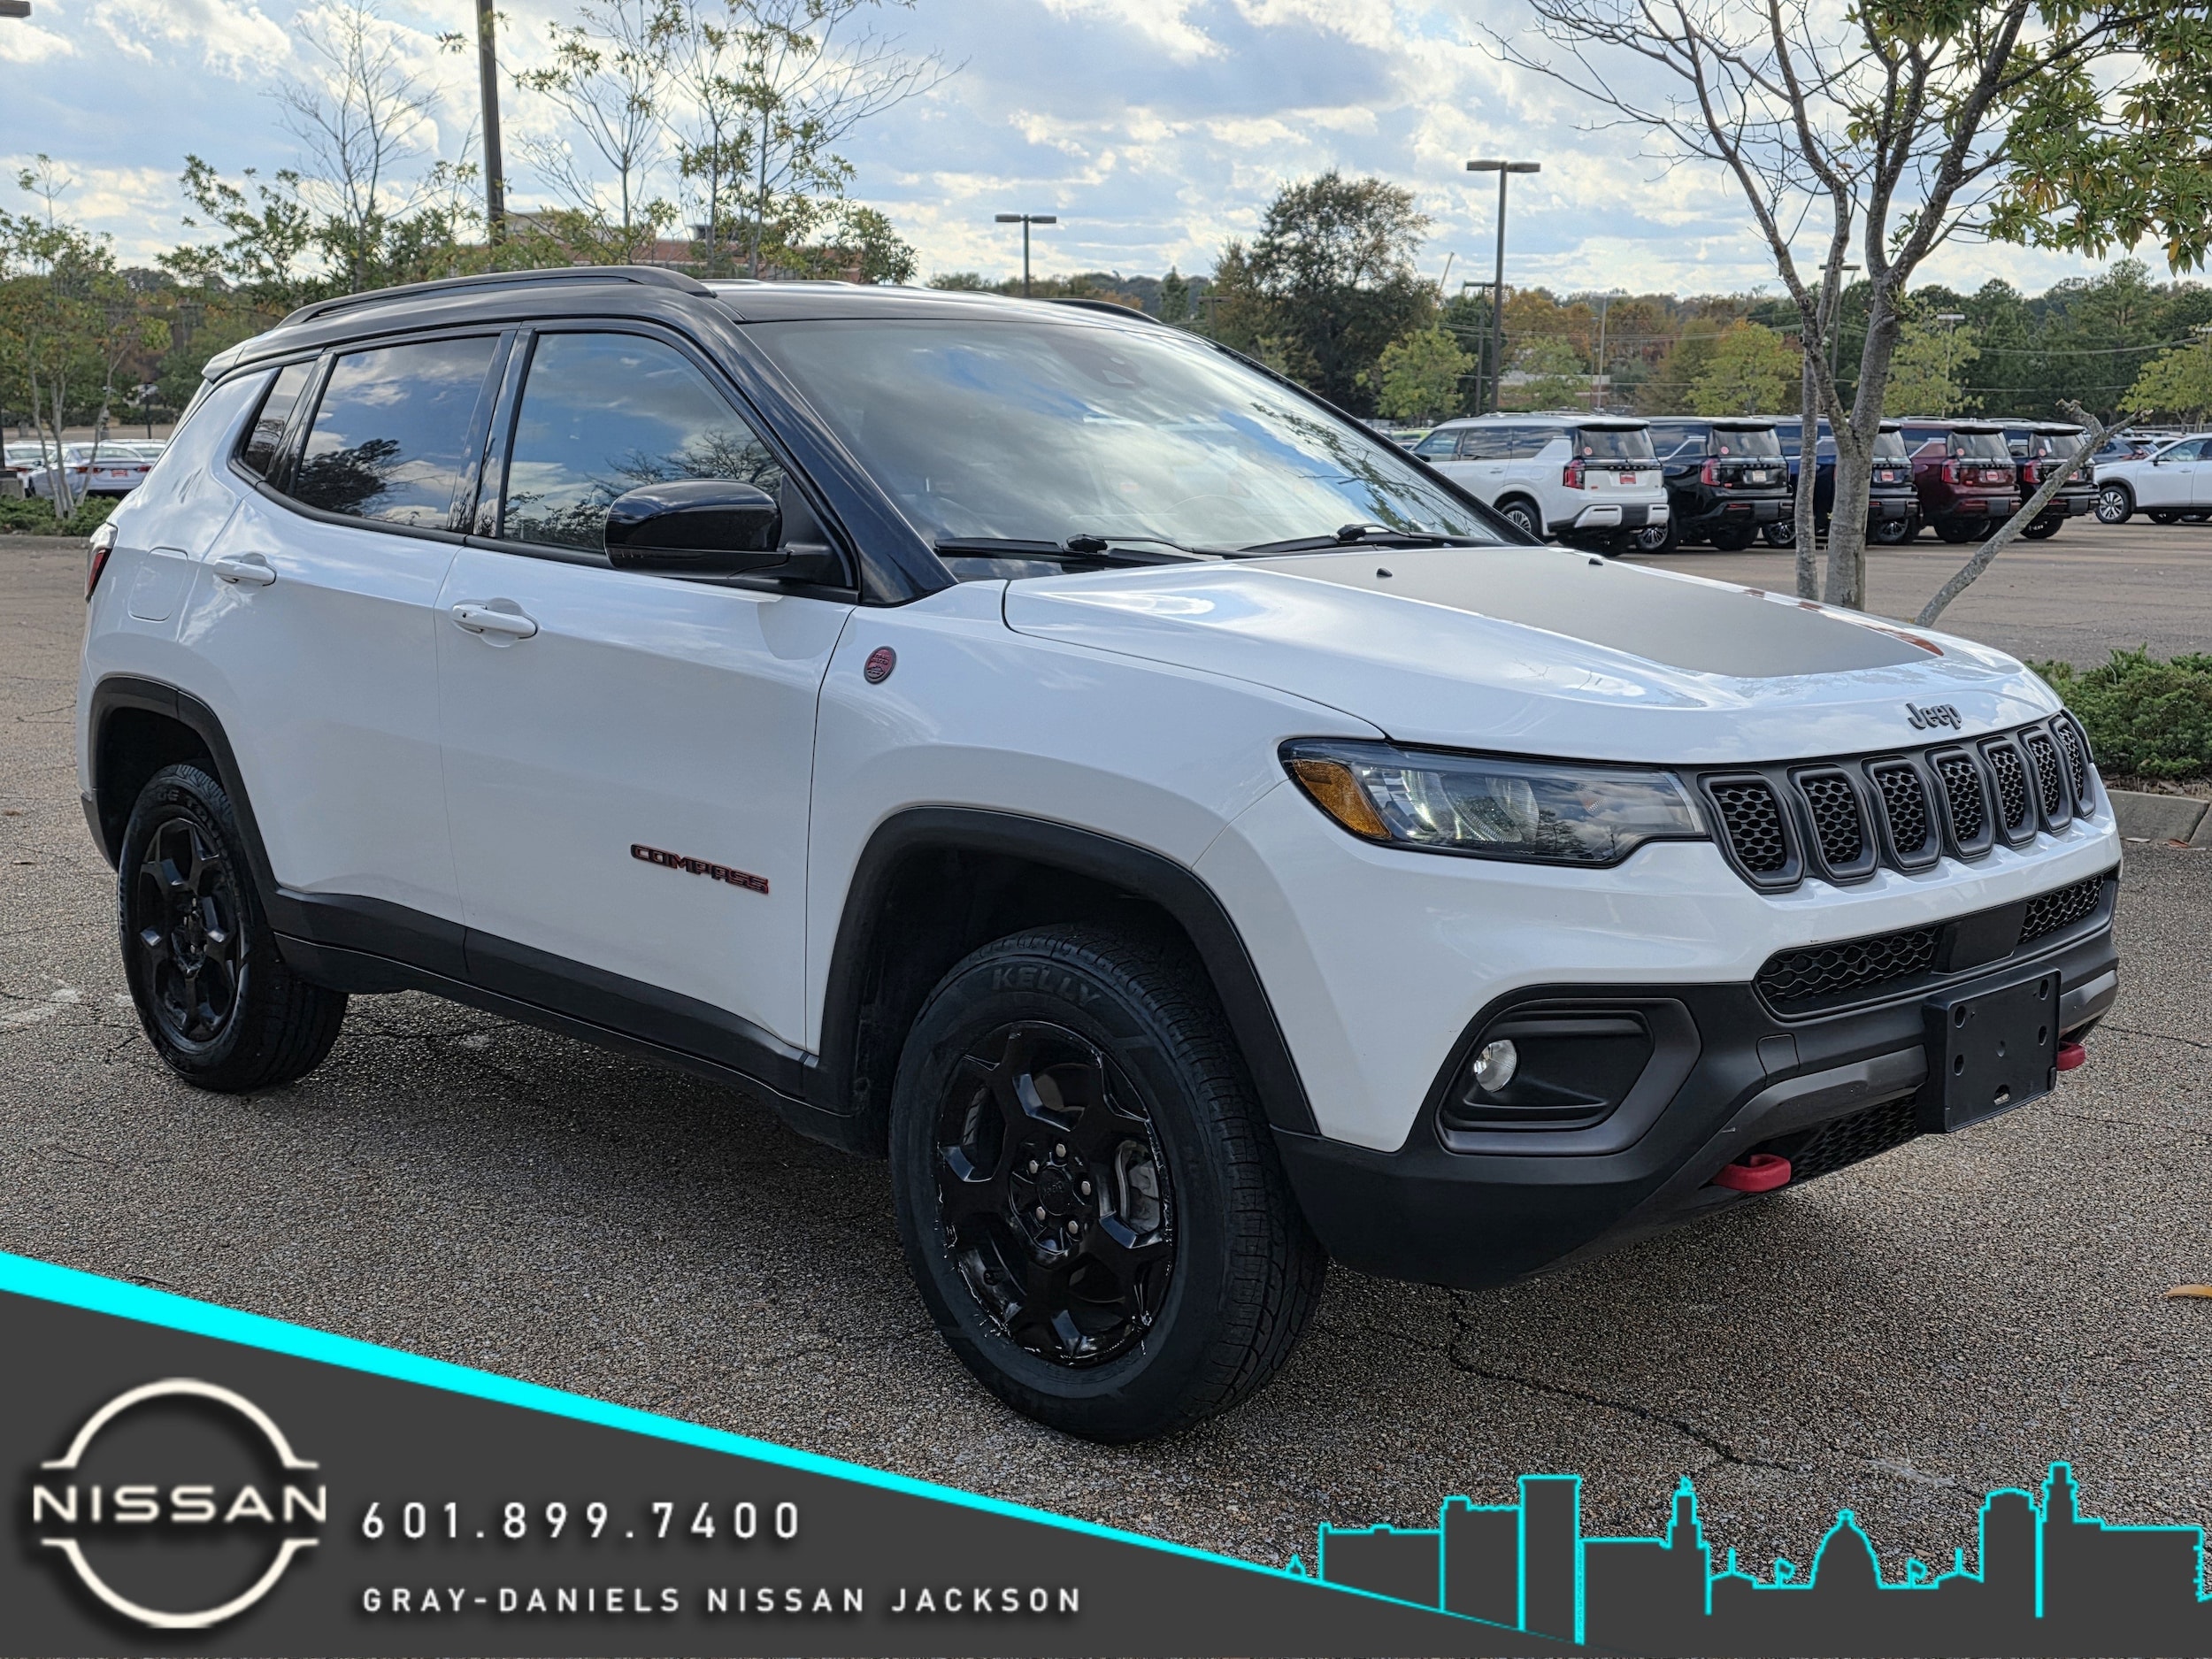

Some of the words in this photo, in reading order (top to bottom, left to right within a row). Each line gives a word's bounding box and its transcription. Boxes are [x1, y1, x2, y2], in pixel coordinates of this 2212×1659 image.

[1906, 703, 1962, 730] Jeep
[630, 843, 769, 895] COMPASS
[992, 966, 1101, 1007] KELLY
